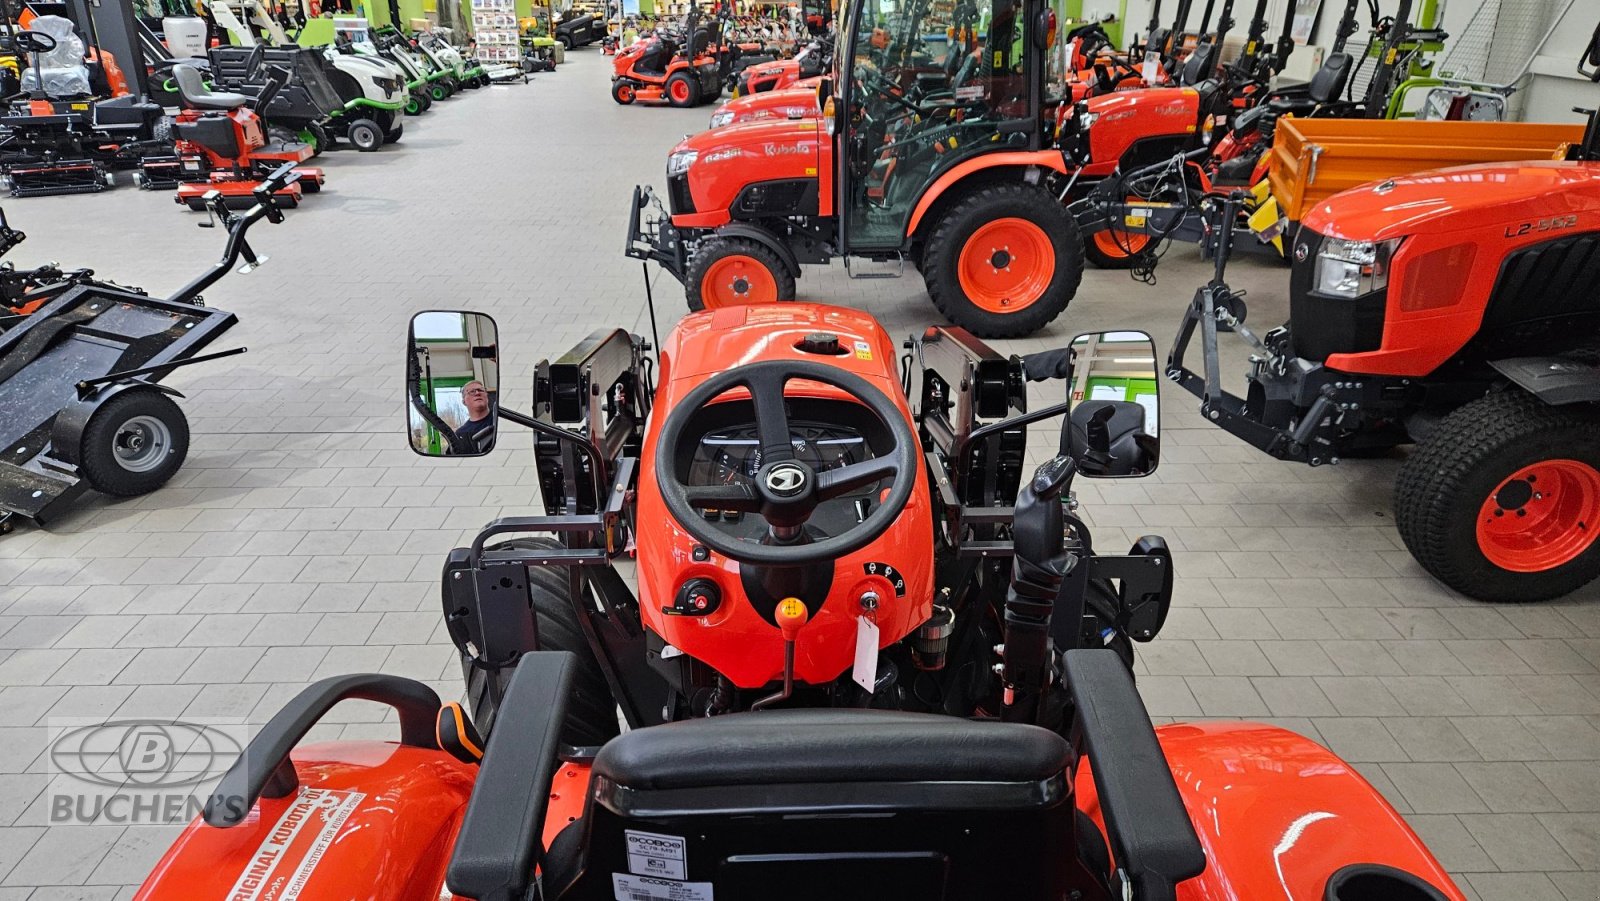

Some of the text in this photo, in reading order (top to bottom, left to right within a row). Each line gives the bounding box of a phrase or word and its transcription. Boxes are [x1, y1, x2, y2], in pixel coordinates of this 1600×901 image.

[764, 144, 810, 156] Kubota
[232, 849, 281, 901] RIGINAL
[264, 876, 286, 901] ubota
